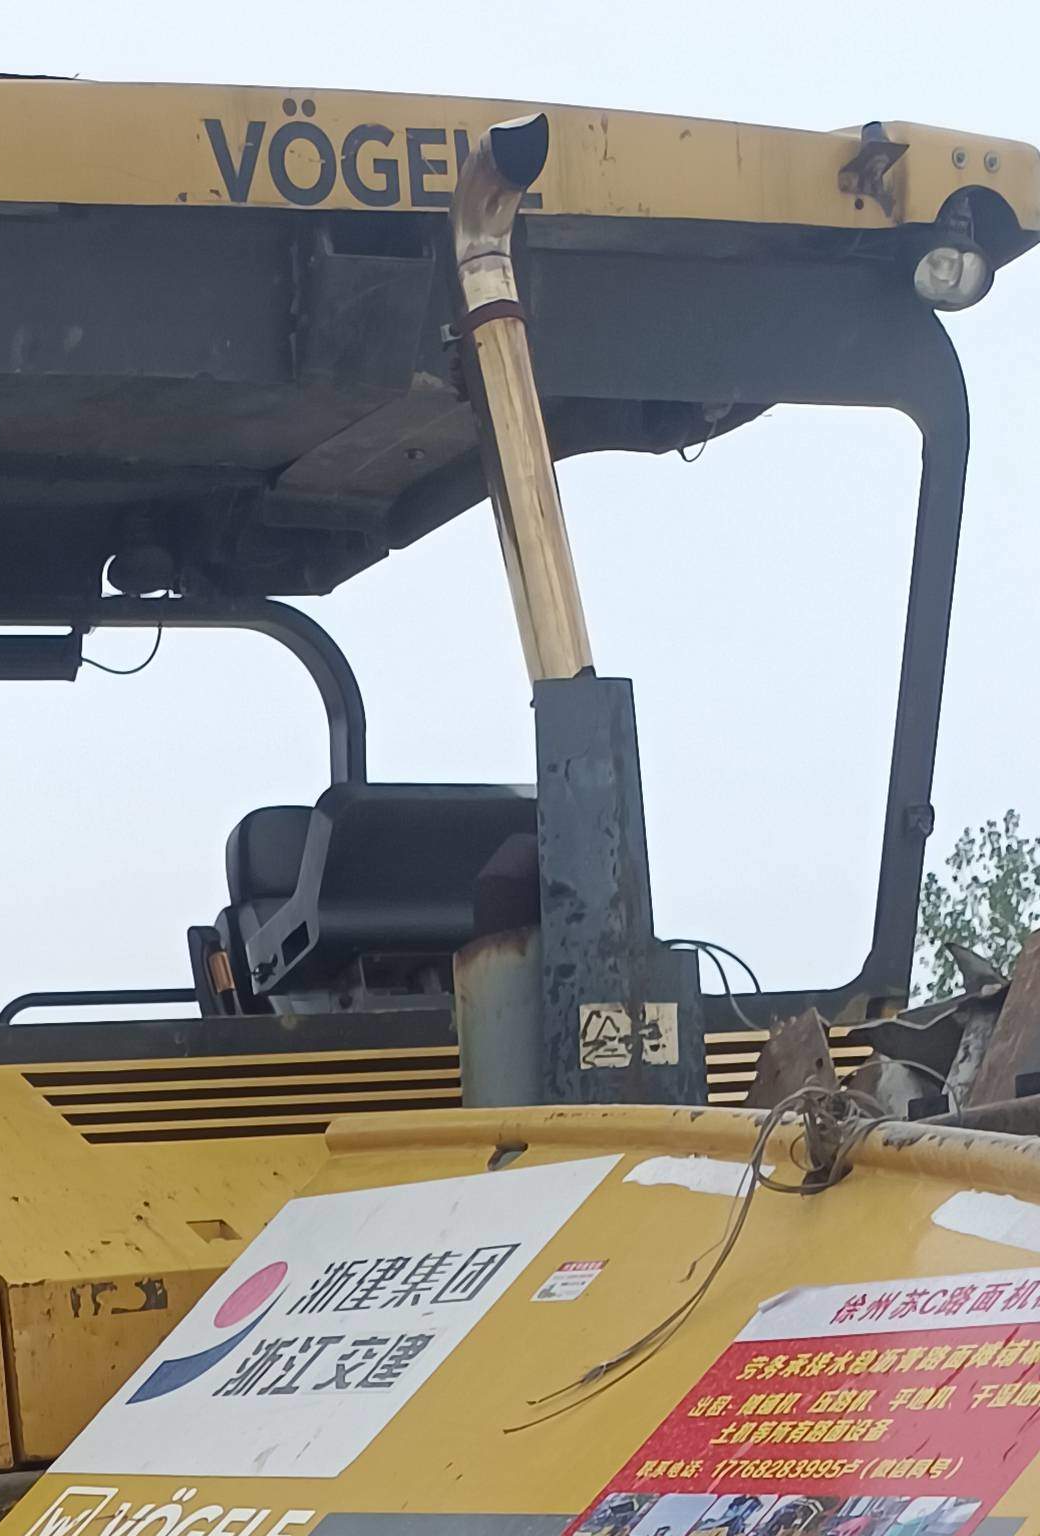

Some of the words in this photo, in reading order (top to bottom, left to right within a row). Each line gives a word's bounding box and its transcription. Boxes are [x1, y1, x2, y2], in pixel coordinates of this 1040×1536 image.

[205, 97, 543, 210] VÖGE
[286, 1242, 521, 1315] 浙建集团
[212, 1332, 434, 1398] 浙江交建
